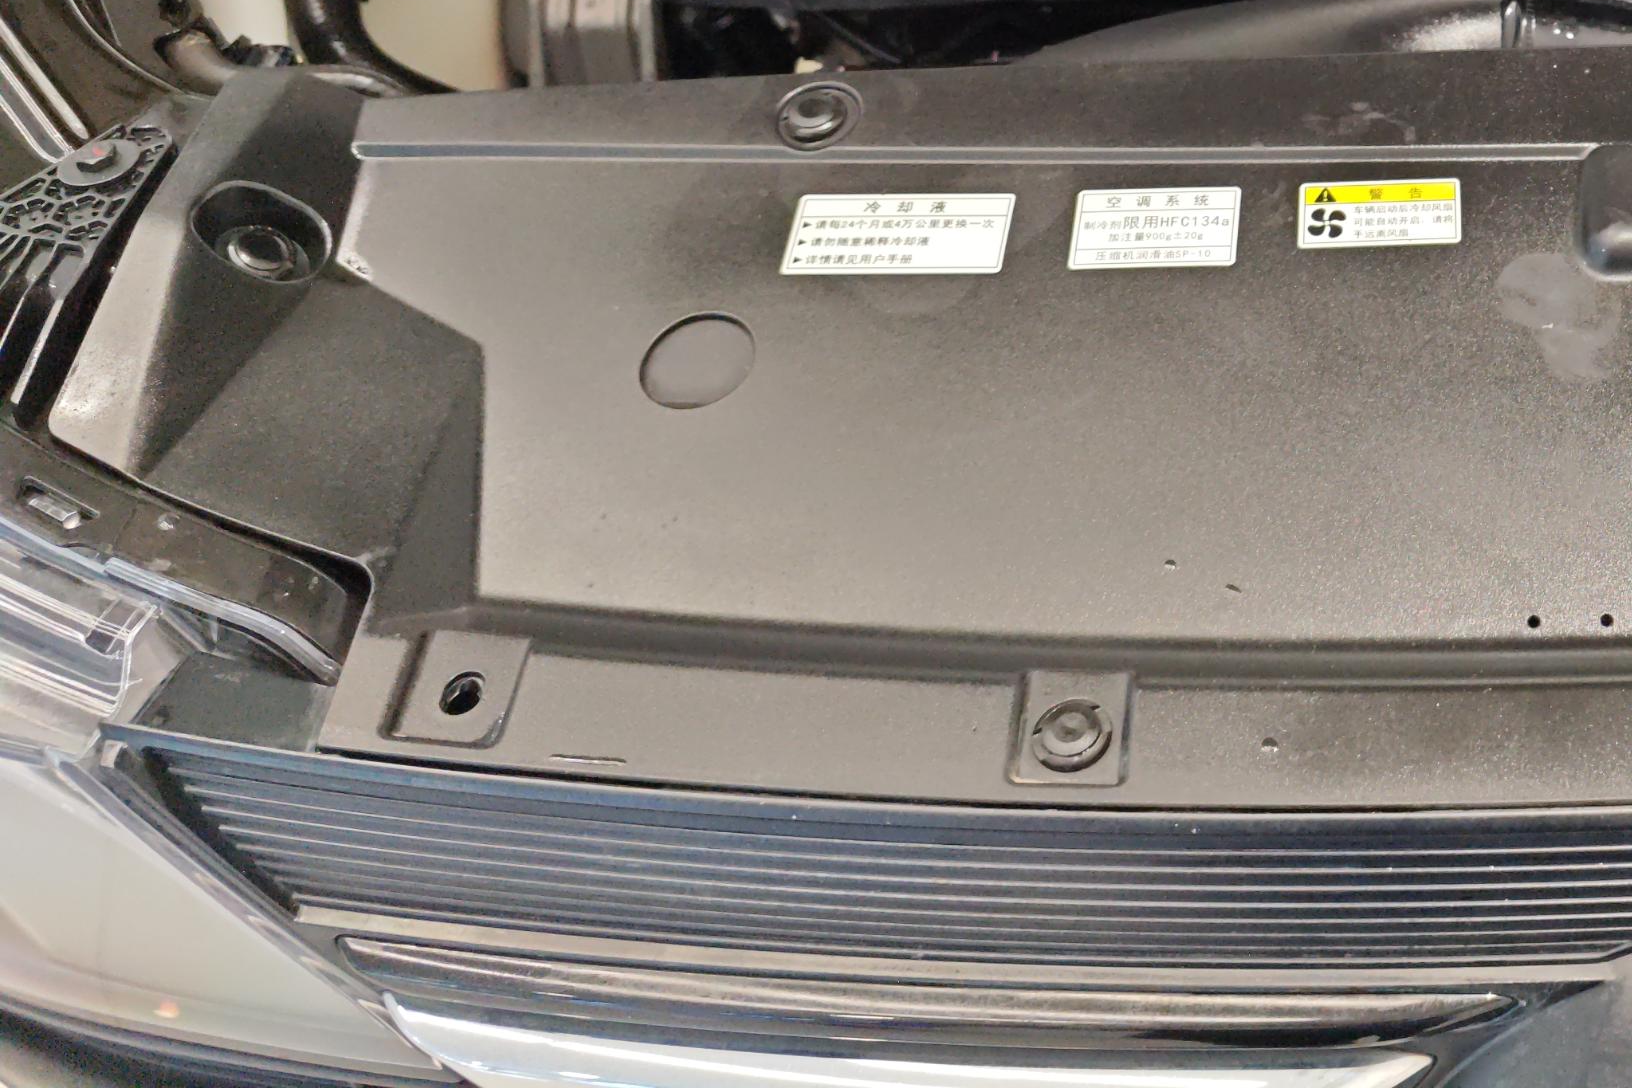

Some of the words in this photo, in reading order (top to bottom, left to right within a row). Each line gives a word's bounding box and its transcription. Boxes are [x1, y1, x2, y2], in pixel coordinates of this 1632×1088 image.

[1369, 187, 1423, 200] 警告
[863, 200, 947, 214] 冷却液
[1106, 194, 1209, 209] 空调系统
